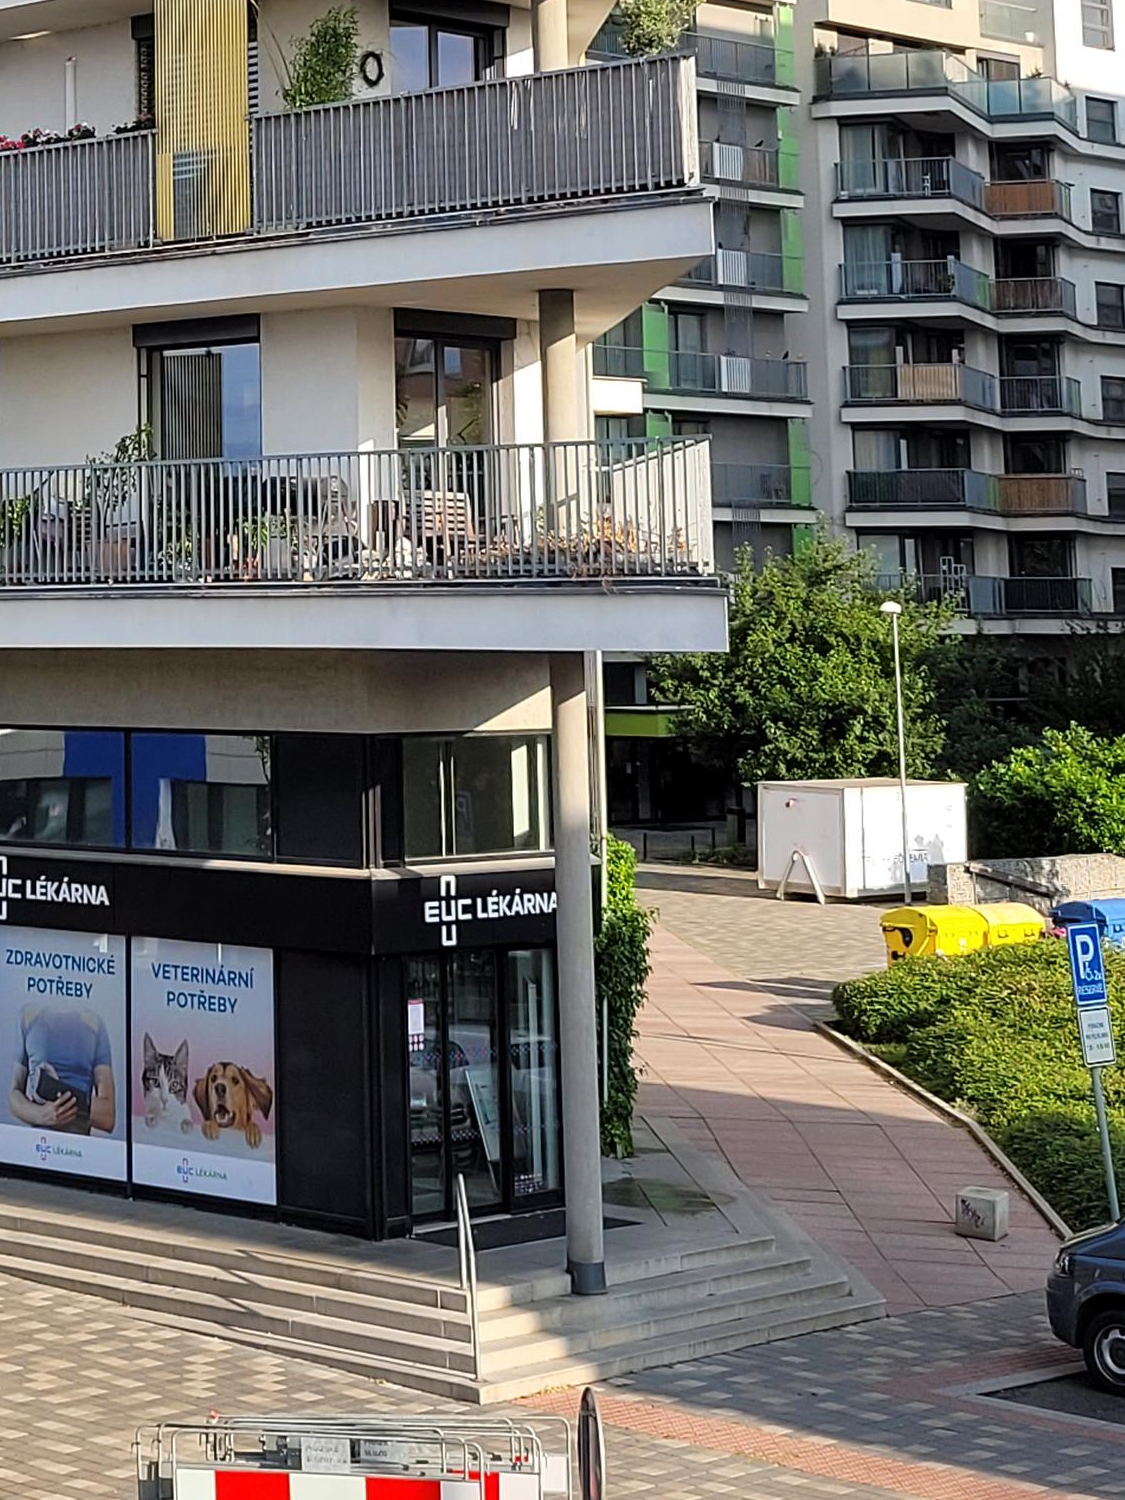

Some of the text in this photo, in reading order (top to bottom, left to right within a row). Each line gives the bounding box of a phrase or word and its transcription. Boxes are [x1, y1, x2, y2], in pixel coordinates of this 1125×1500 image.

[25, 875, 110, 906] LÉKÁRNA
[476, 887, 557, 919] LÉKÁRNA
[6, 949, 115, 975] ZDRAVOTNICKÉ
[1075, 934, 1094, 979] P
[27, 976, 93, 999] POTŘEBY
[151, 962, 254, 989] VETERINÁRNÍ
[166, 989, 238, 1014] POTŘEBY
